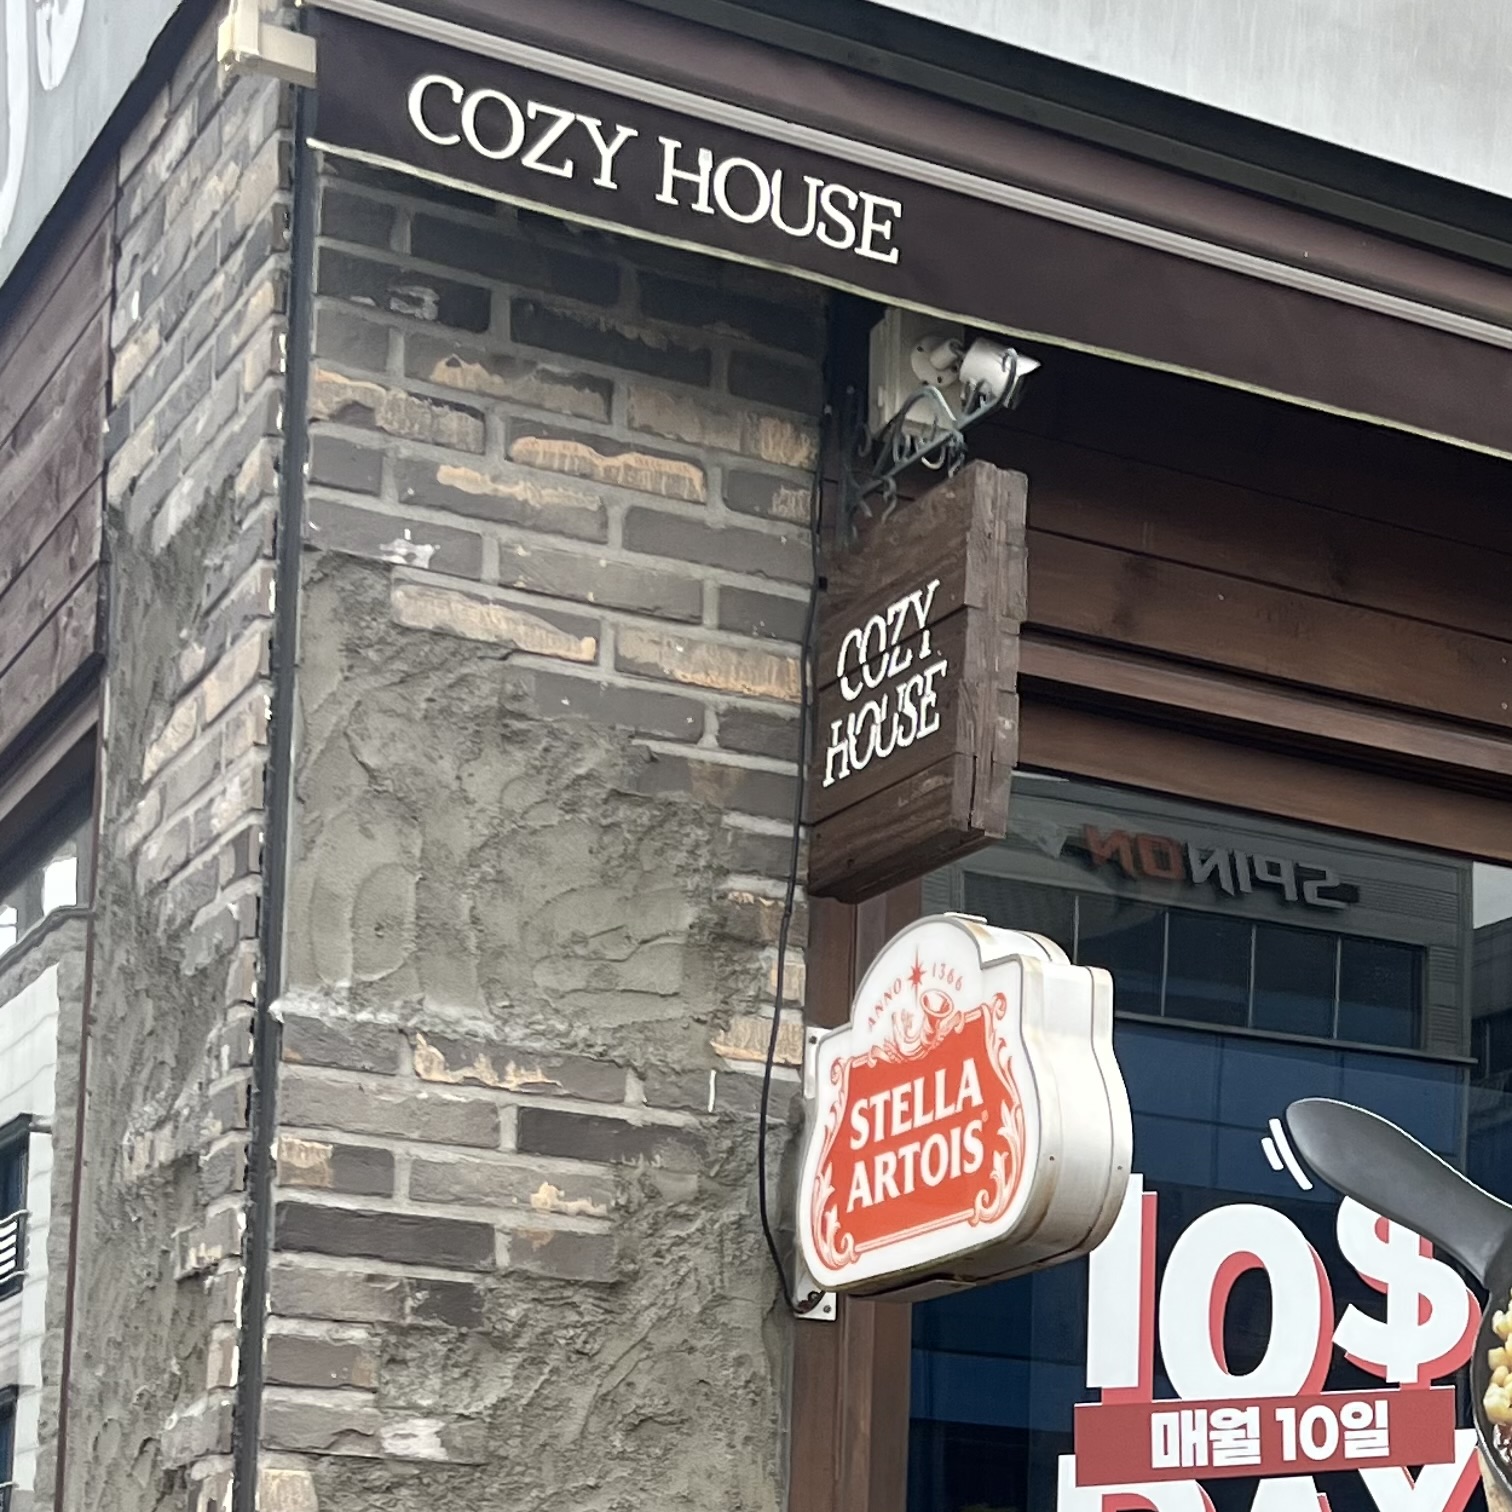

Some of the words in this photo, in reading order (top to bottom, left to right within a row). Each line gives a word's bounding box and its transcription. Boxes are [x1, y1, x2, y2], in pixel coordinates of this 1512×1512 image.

[408, 74, 638, 190] COZY
[655, 136, 902, 264] HOUSE
[837, 579, 940, 701] COZY
[822, 659, 947, 787] HOUSE
[868, 978, 902, 1032] ANNO
[931, 962, 963, 991] 1366
[850, 1057, 984, 1150] STELLA
[846, 1119, 985, 1213] ARTOIS
[1086, 1173, 1482, 1404] 10$
[1150, 1405, 1262, 1470] 매월
[1274, 1400, 1391, 1462] 10일
